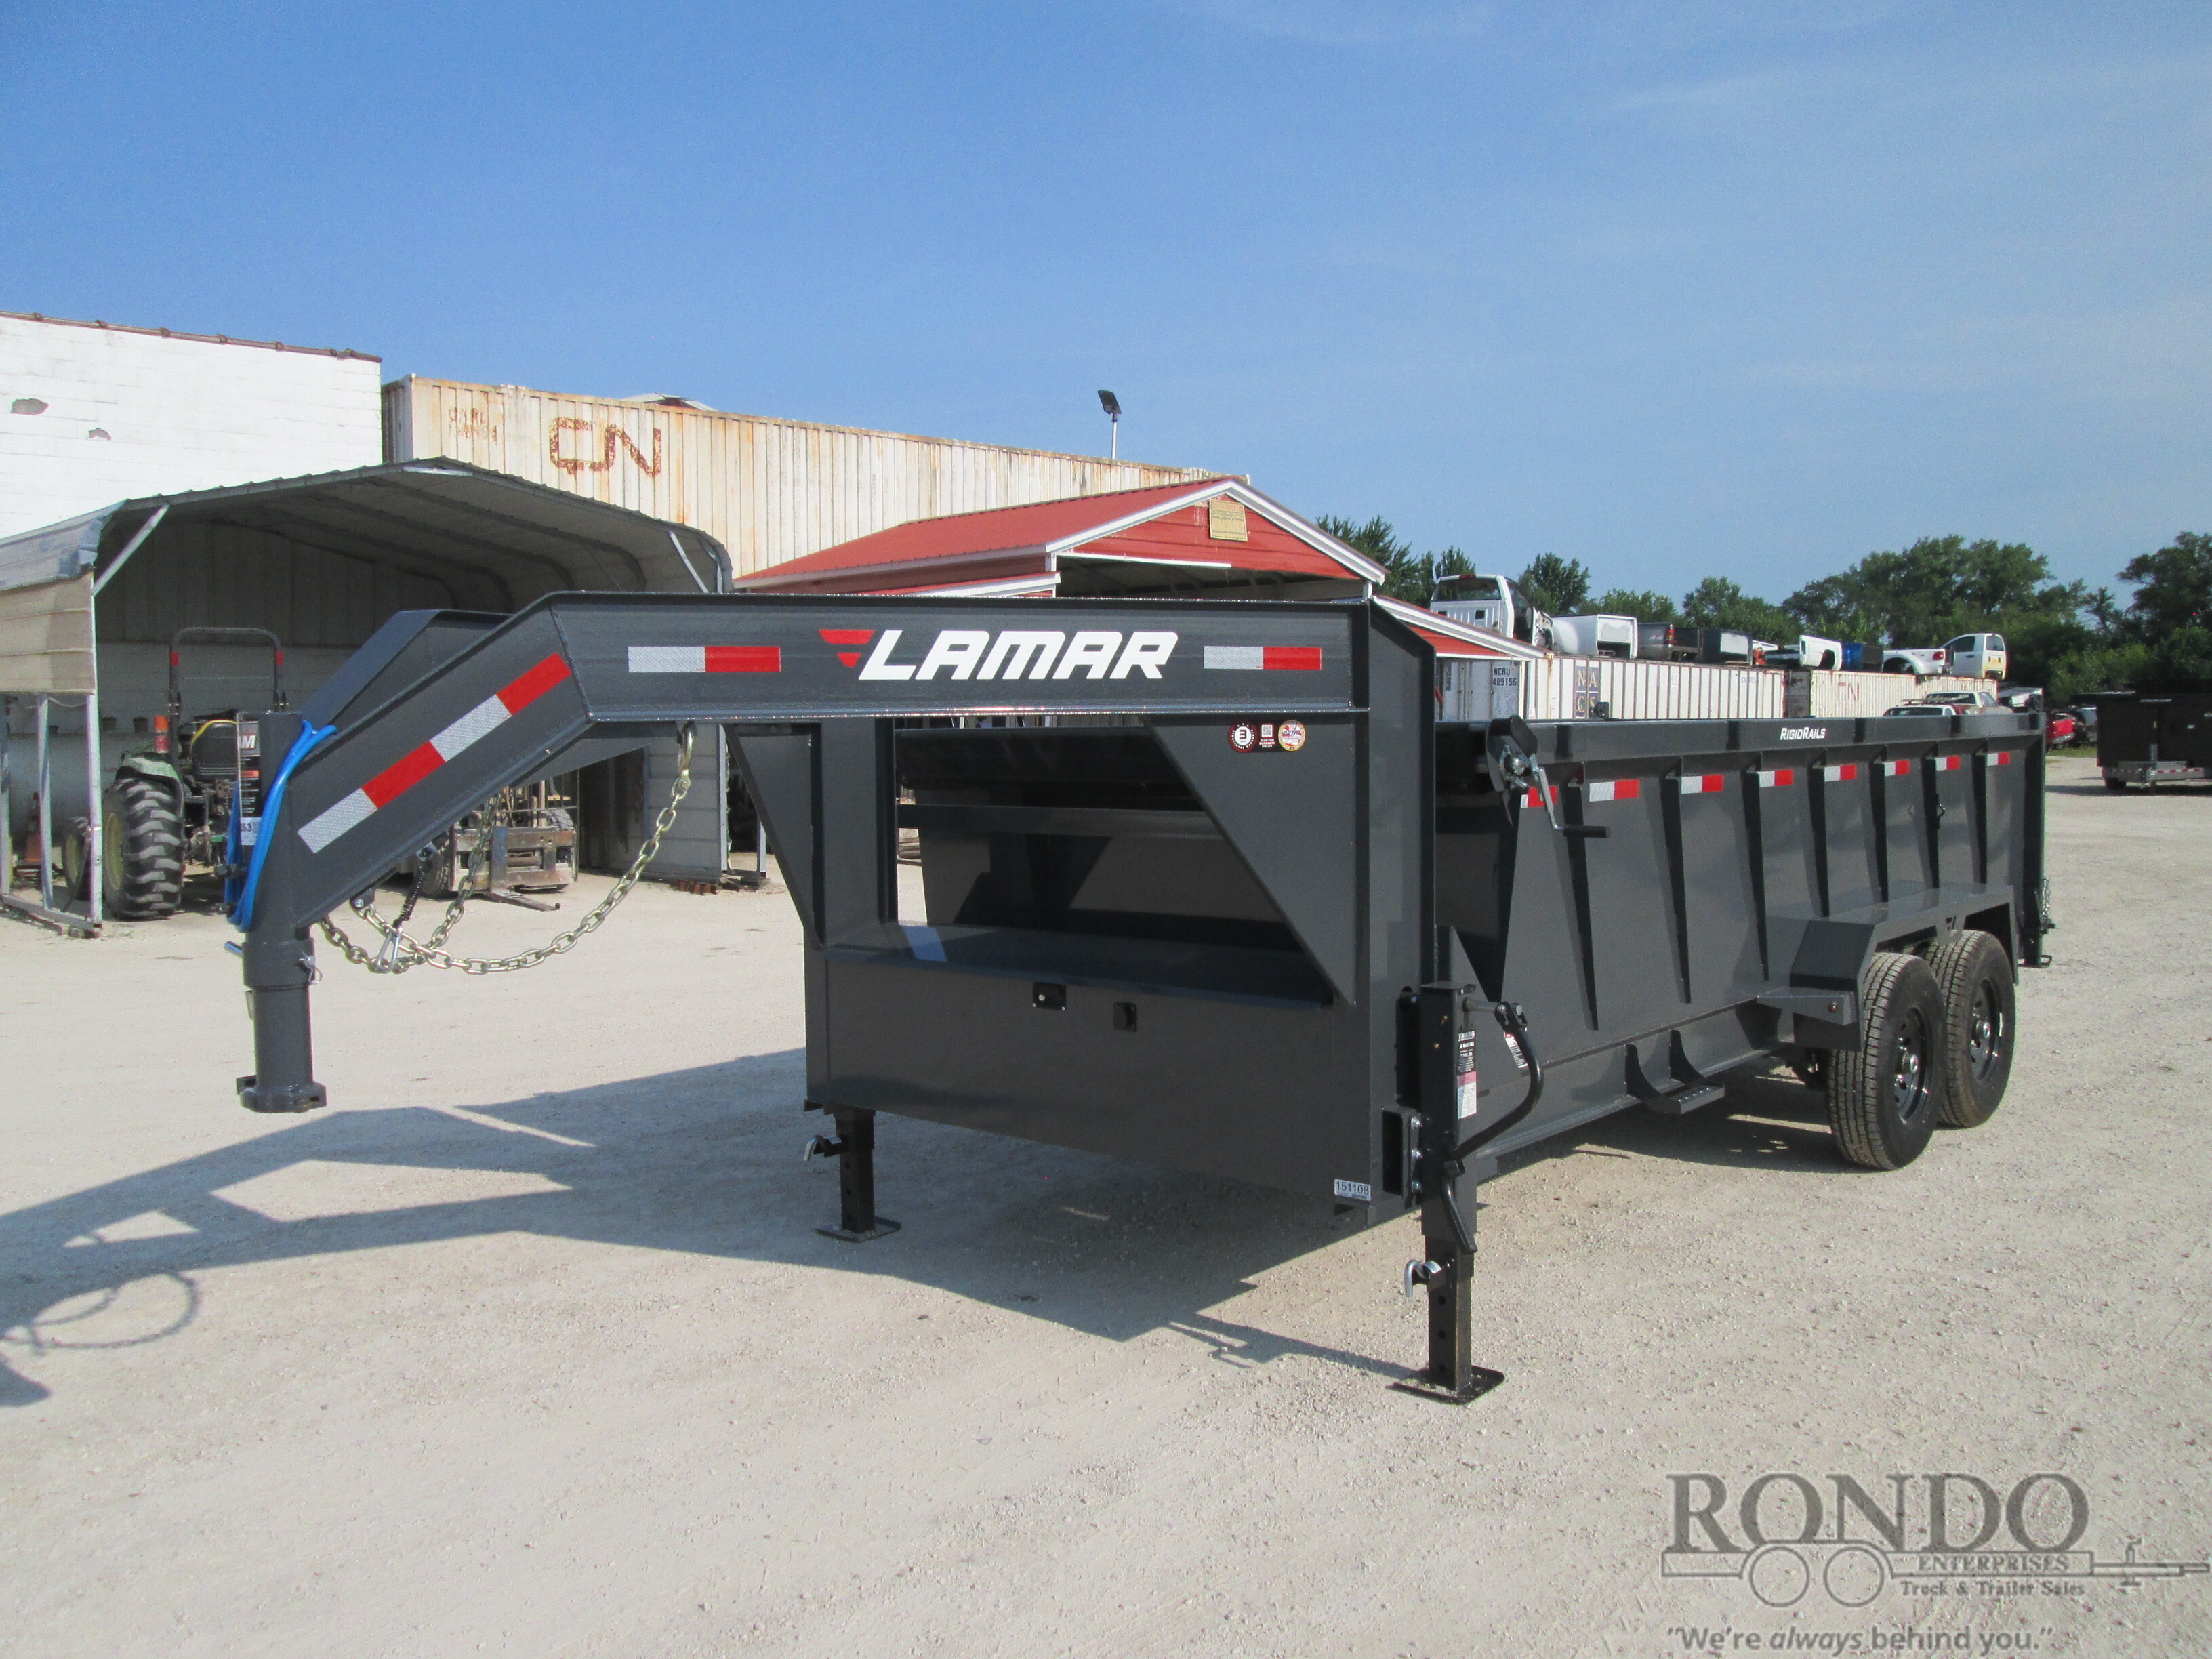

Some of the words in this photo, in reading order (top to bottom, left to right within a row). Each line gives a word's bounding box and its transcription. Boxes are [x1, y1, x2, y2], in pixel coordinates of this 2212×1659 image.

[550, 417, 661, 477] CN
[858, 630, 1179, 680] LAMAR
[1494, 668, 1511, 676] NCRU
[1336, 1181, 1369, 1195] 151108
